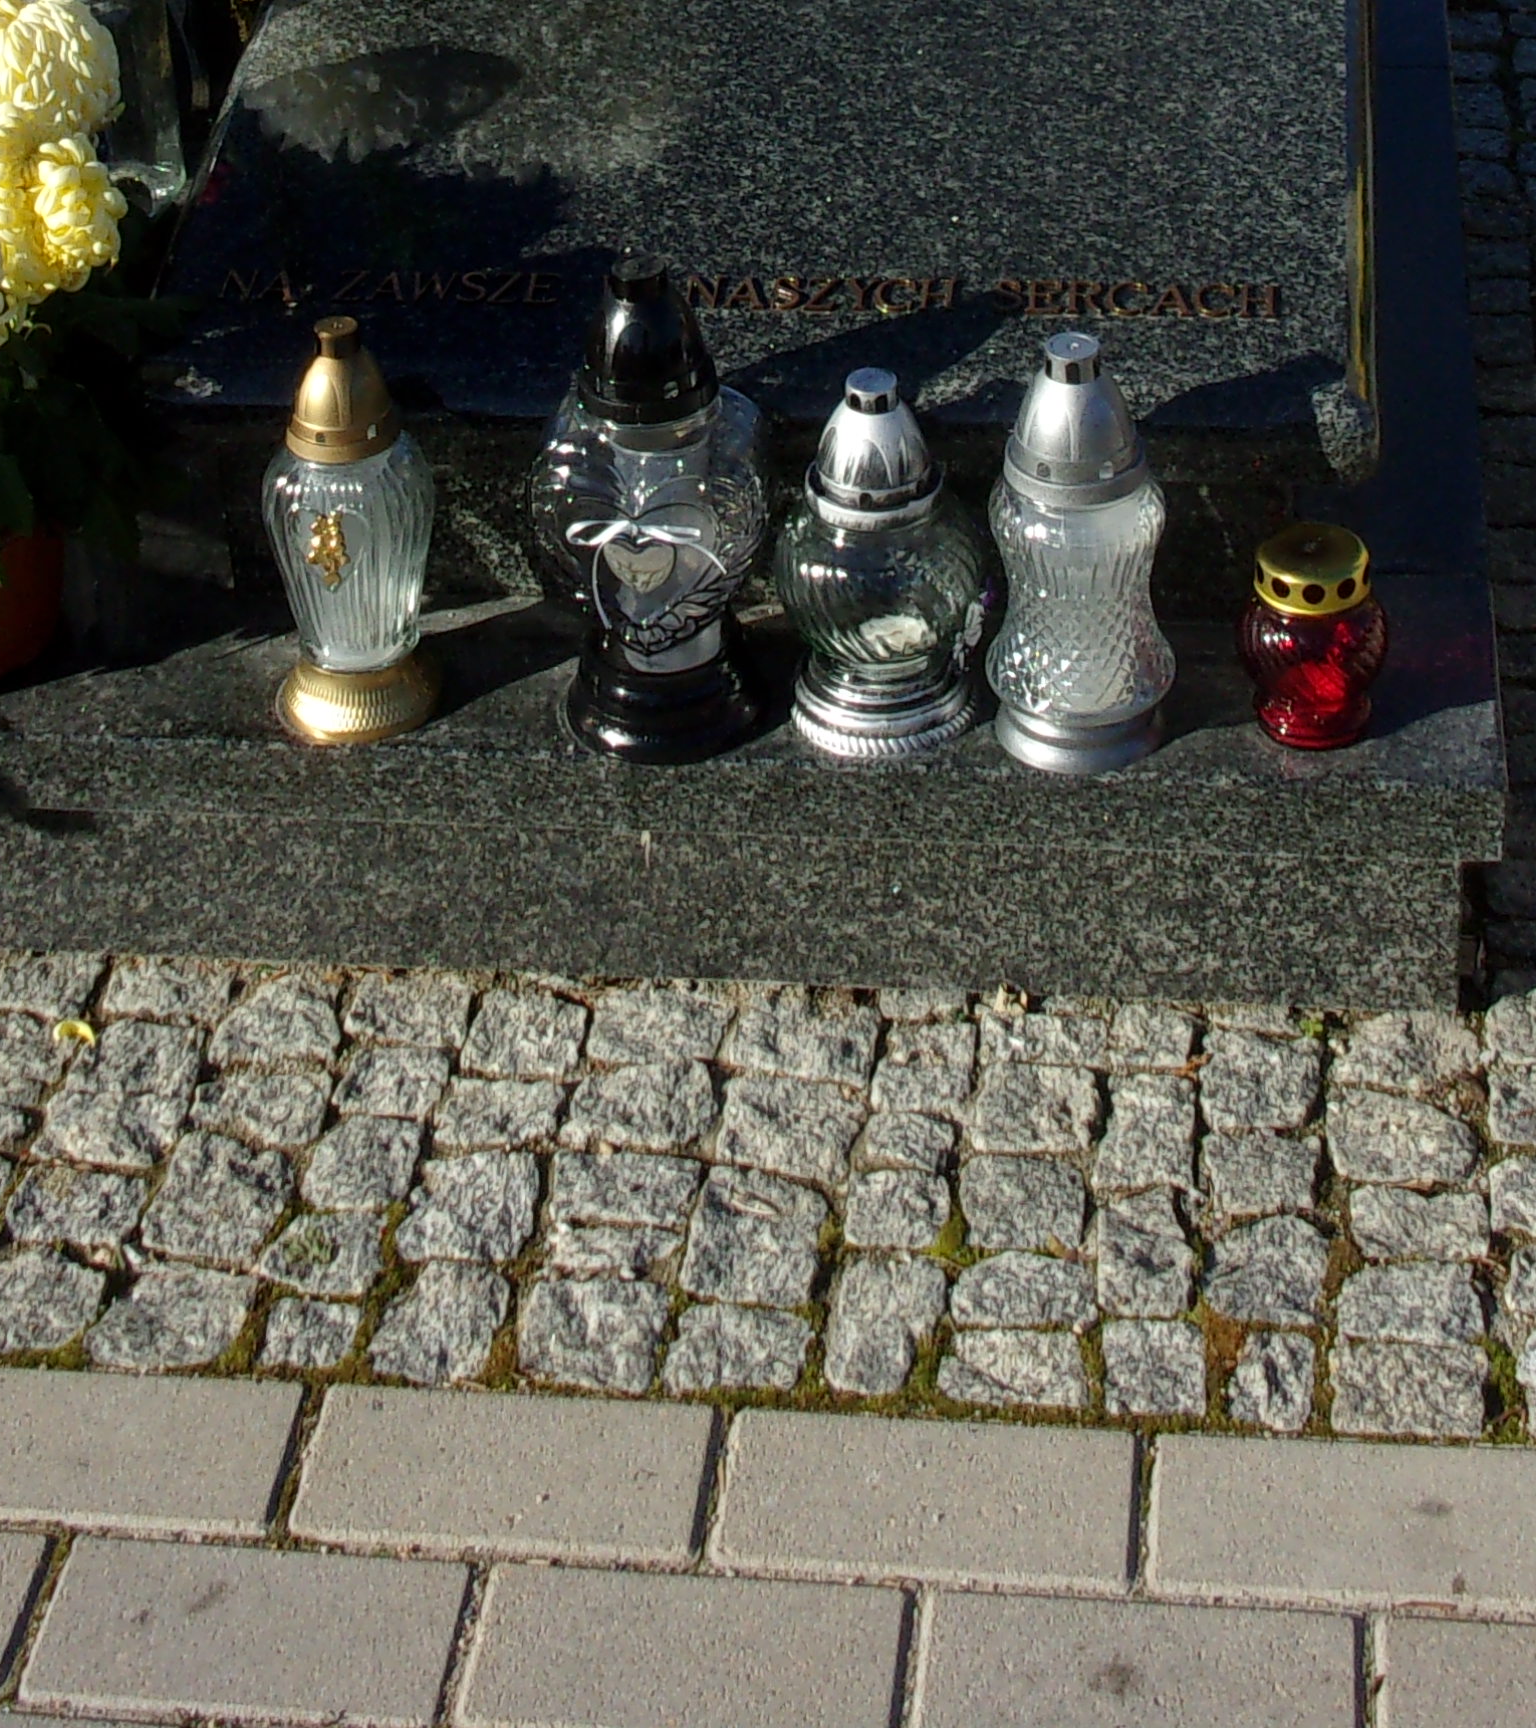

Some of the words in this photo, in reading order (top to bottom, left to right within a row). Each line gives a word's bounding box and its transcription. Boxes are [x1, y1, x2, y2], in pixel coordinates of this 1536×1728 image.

[218, 268, 295, 305] NA
[330, 267, 563, 306] ZAWSZE
[686, 274, 959, 317] NASZYCH
[991, 276, 1282, 320] SERCACH
